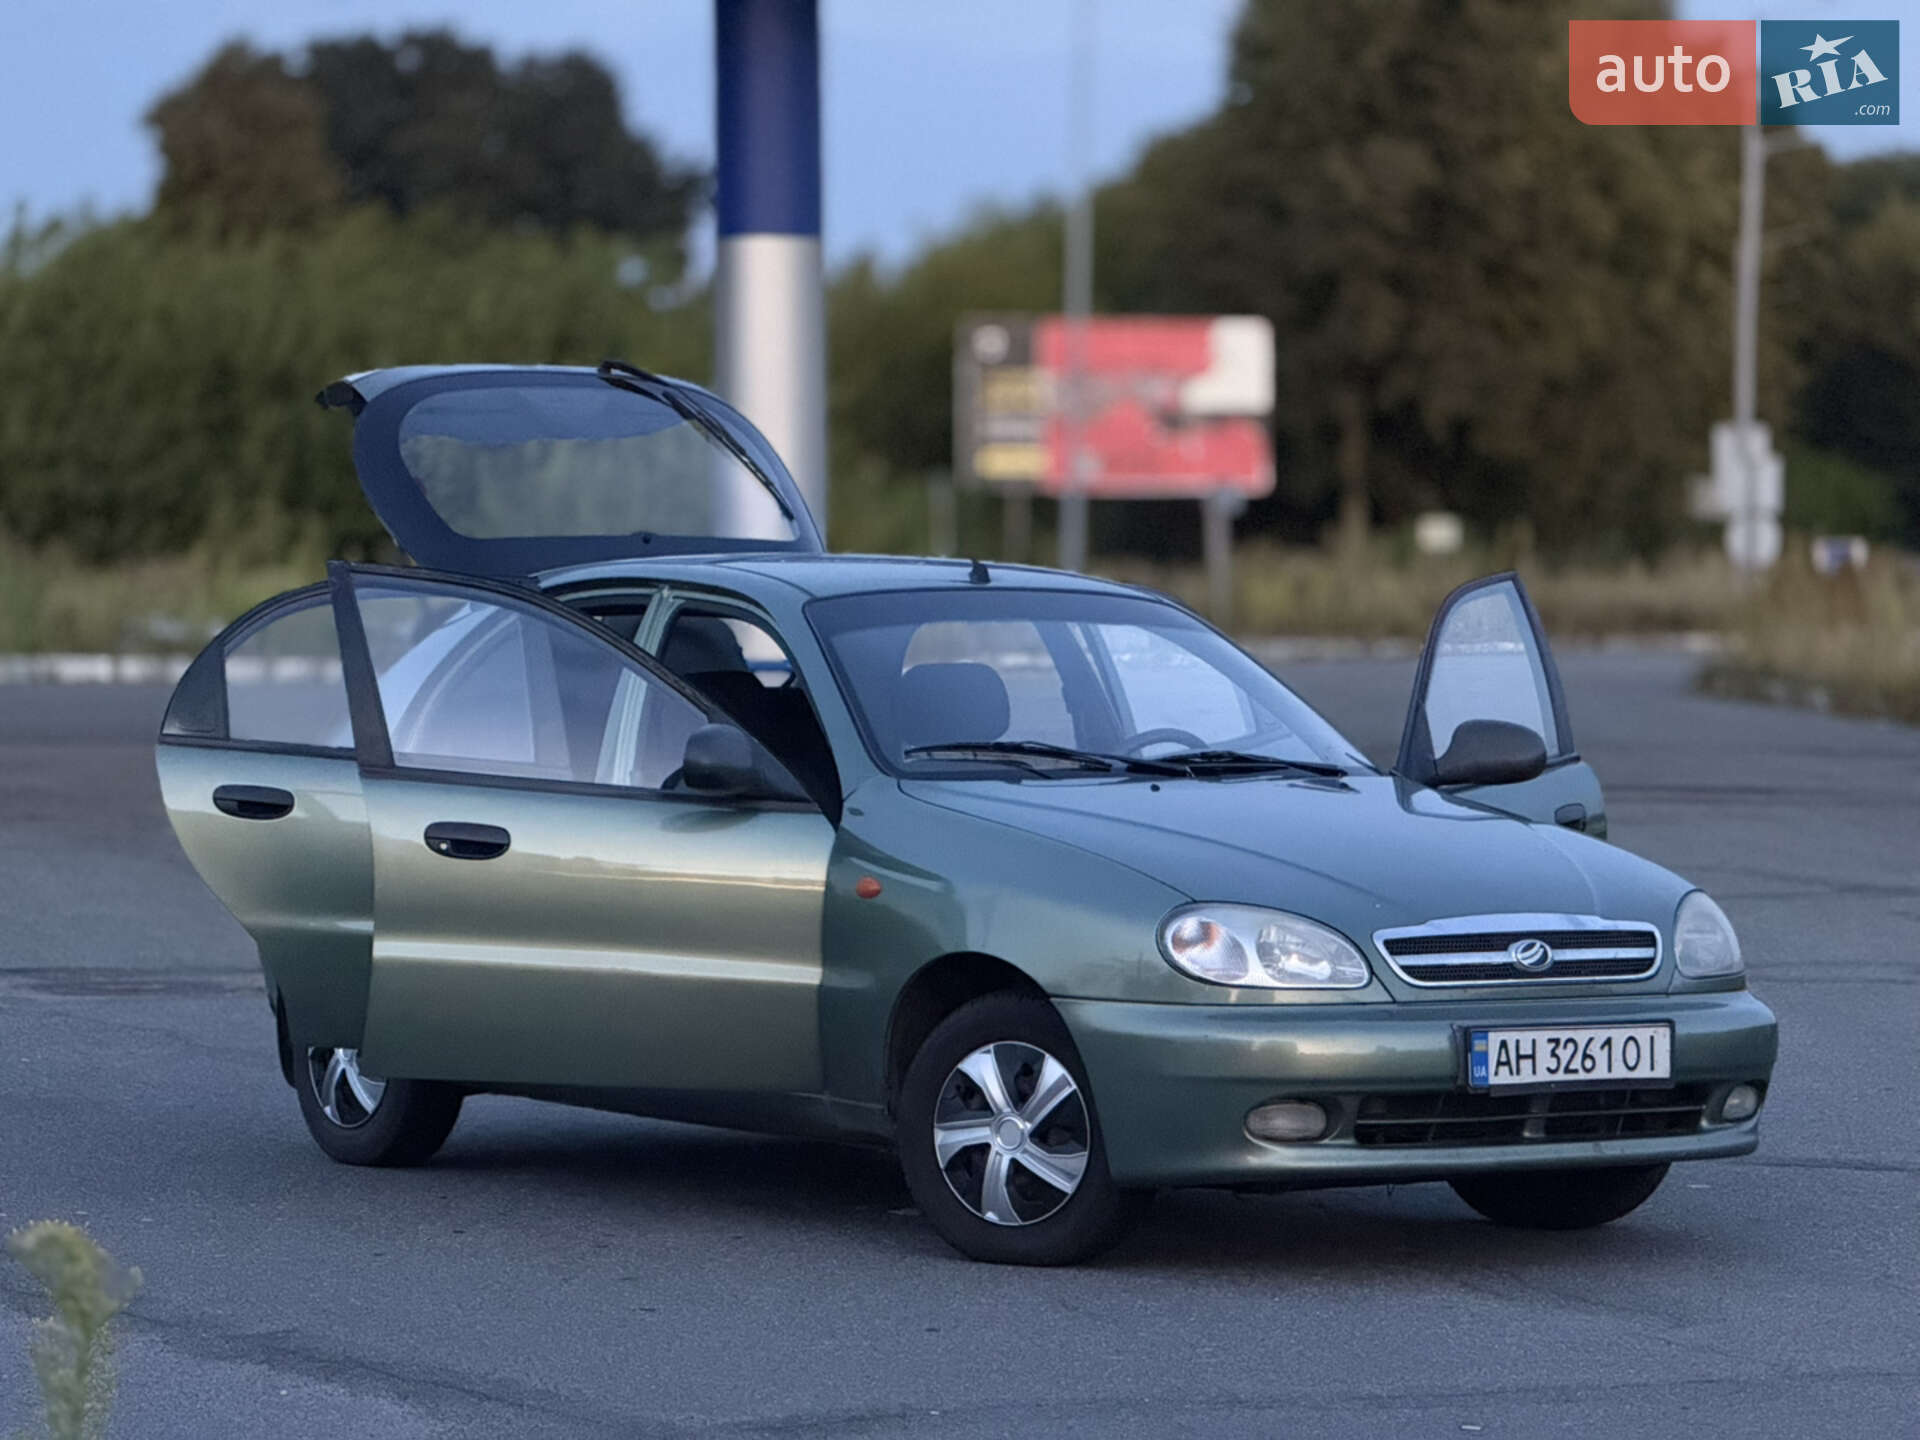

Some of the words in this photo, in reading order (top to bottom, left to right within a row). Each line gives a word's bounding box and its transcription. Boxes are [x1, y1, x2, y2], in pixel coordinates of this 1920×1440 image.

[1493, 1038, 1537, 1077] AH
[1546, 1036, 1613, 1075] 3261
[1473, 1067, 1488, 1078] UA
